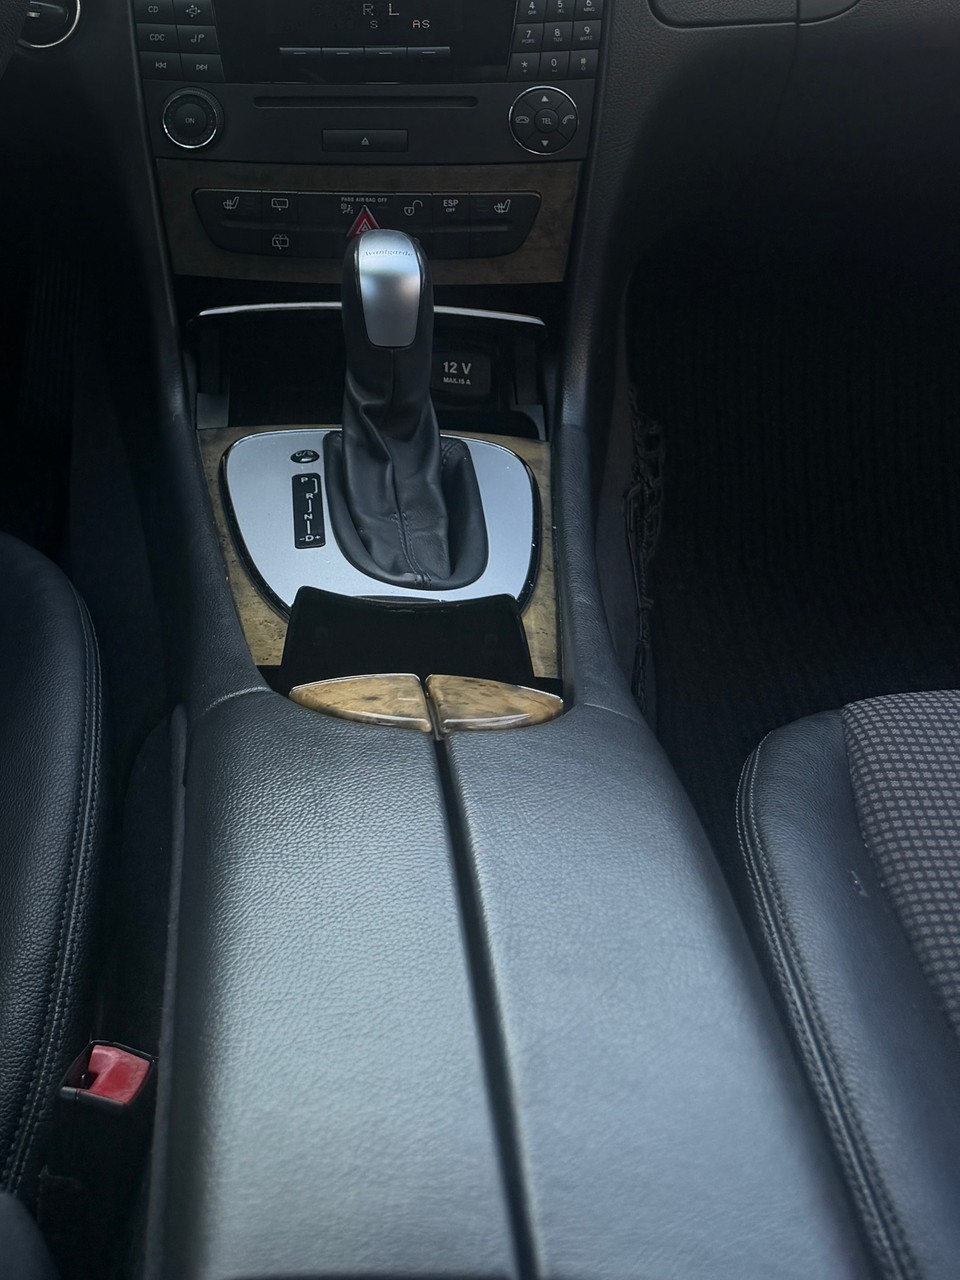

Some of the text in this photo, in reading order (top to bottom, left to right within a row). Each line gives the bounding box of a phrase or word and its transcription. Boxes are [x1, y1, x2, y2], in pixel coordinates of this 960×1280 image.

[557, 0, 563, 8] 5
[389, 3, 399, 15] L
[413, 20, 430, 28] AS
[526, 30, 531, 38] 7
[554, 28, 560, 36] 8
[584, 26, 590, 34] 9
[150, 33, 165, 41] CDC
[443, 361, 472, 375] 12 V
